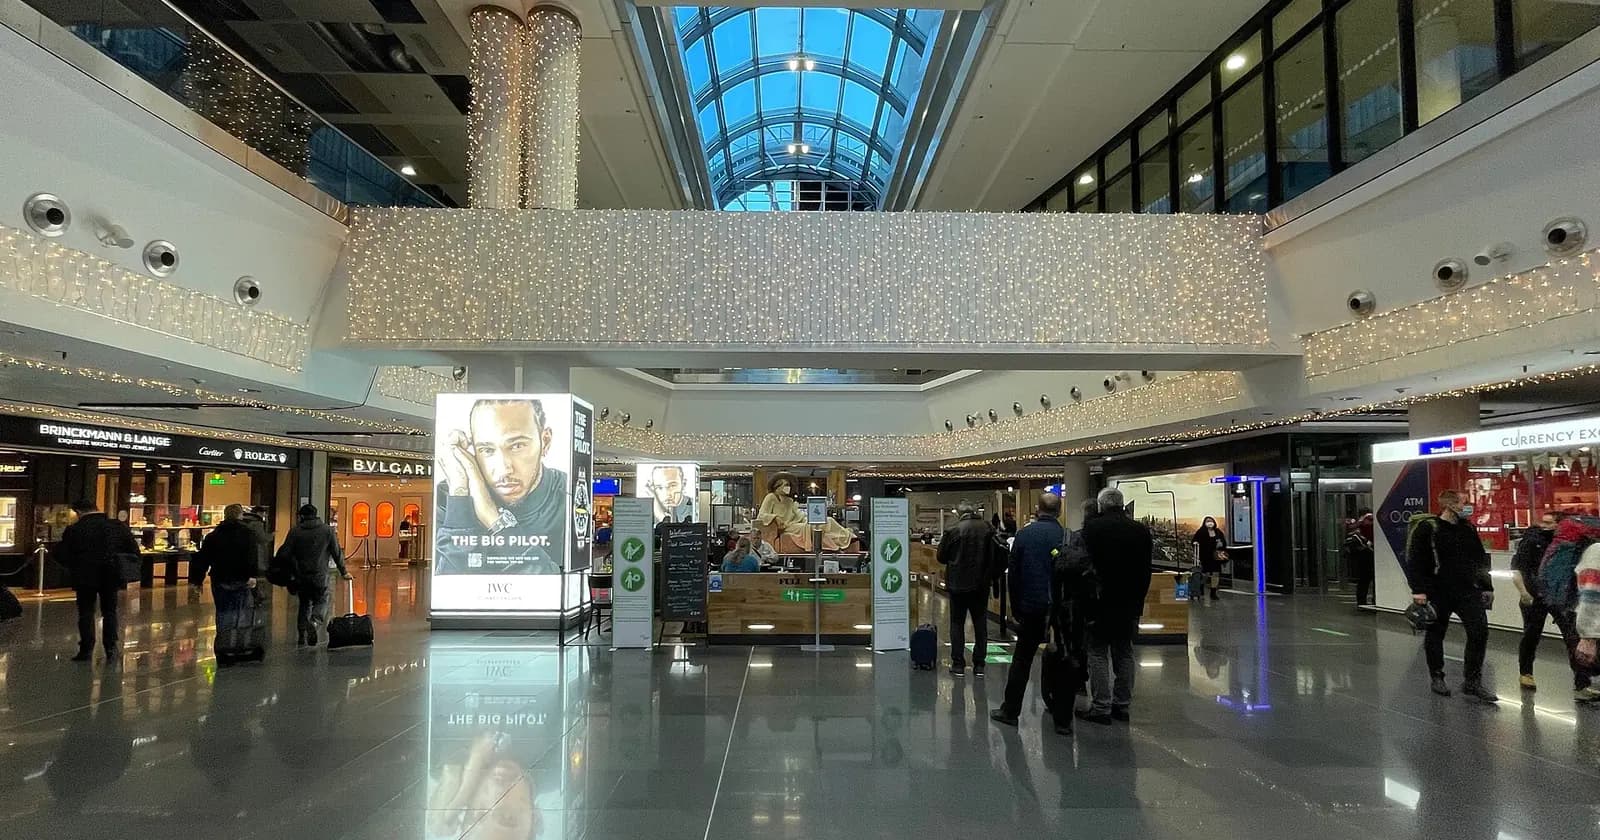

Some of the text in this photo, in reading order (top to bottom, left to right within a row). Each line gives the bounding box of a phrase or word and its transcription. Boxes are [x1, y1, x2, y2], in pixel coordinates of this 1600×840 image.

[575, 410, 587, 428] THE
[39, 424, 172, 447] BRINCKMANN & LANGE
[1501, 431, 1574, 447] CURRENCY
[198, 446, 224, 457] Cartier
[244, 450, 277, 462] ROLEX
[353, 459, 432, 476] BVLGARI
[1404, 497, 1424, 506] ATM
[451, 535, 551, 547] THE BIG PILOT.
[487, 583, 513, 593] IWC
